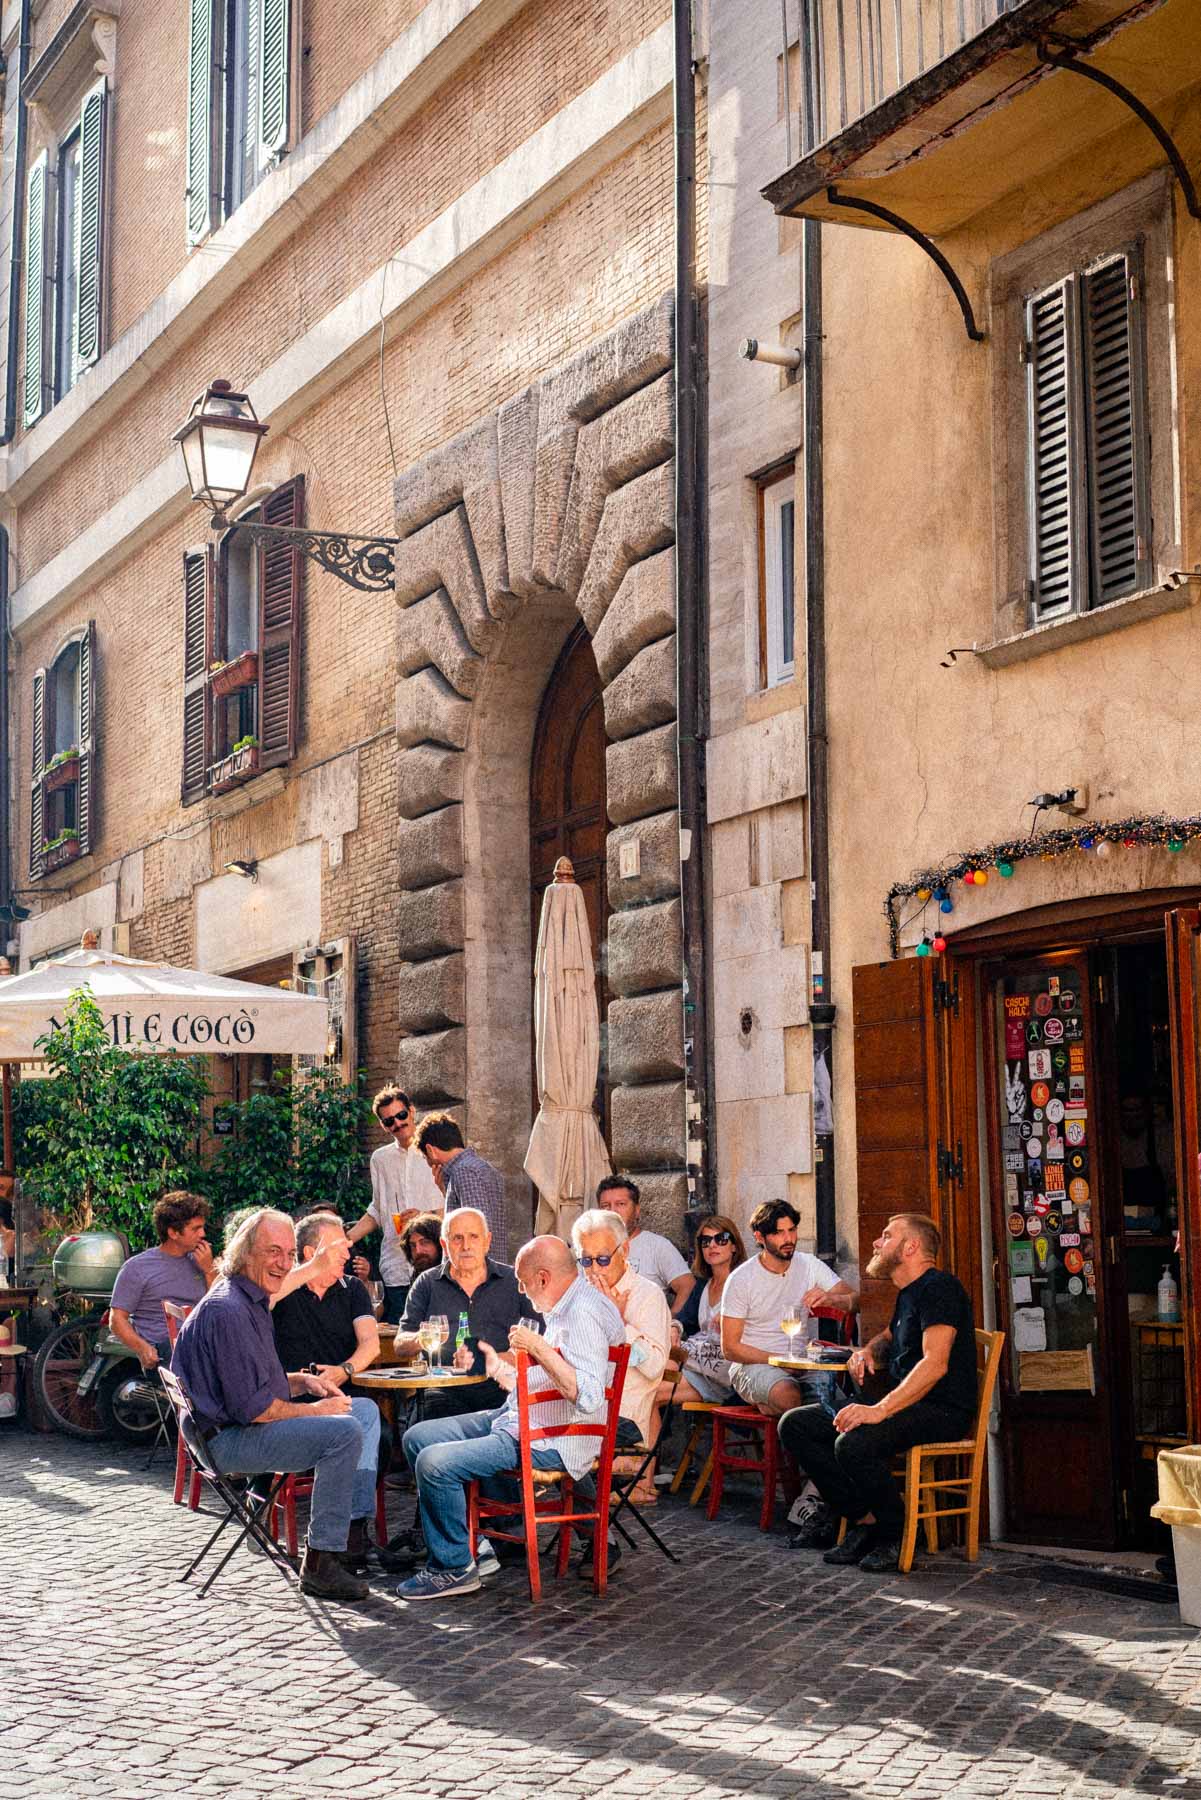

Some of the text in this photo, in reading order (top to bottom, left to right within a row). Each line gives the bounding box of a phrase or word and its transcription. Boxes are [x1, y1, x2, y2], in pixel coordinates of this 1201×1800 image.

[47, 1009, 255, 1046] MMÌ E COCÒ
